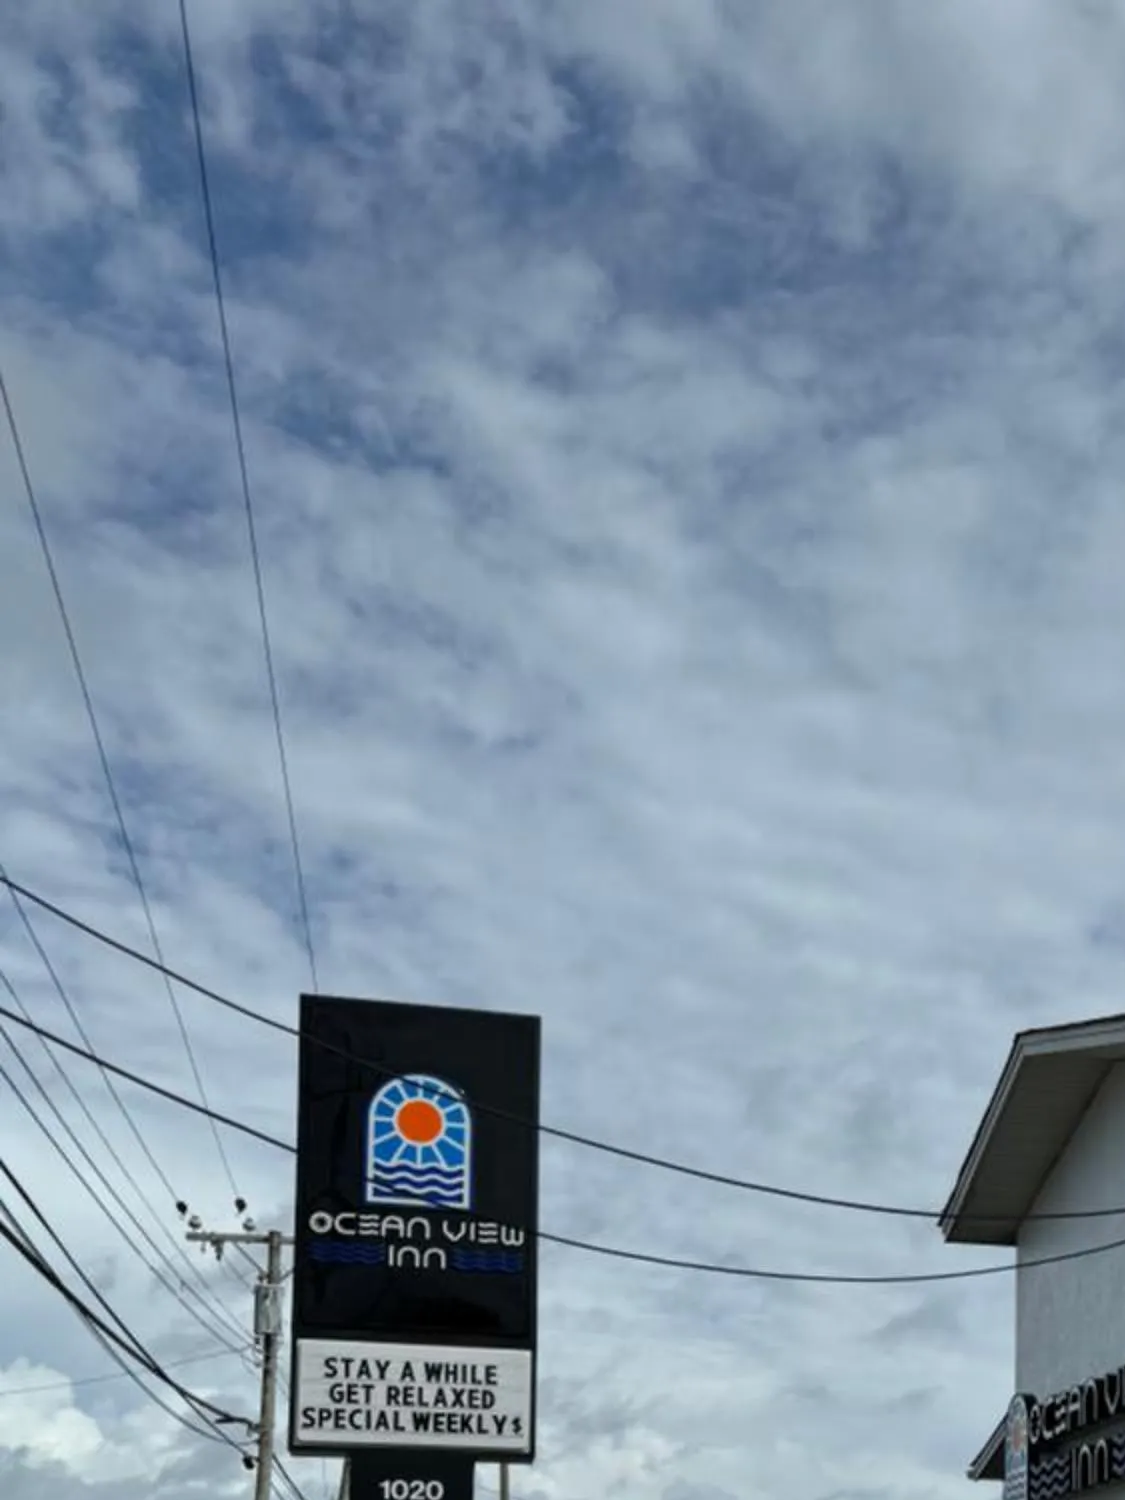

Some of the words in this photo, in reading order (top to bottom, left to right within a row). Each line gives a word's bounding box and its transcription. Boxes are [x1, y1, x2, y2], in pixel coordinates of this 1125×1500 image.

[309, 1211, 431, 1239] OCEAN
[442, 1219, 525, 1246] VIEW
[387, 1245, 447, 1270] INN
[323, 1357, 391, 1381] STAY
[401, 1361, 416, 1382] A
[423, 1362, 498, 1386] WHILE
[329, 1383, 375, 1405] GET
[386, 1386, 496, 1410] RELAXED
[301, 1407, 405, 1432] SPECIAL
[1028, 1379, 1099, 1444] OCEAN
[1071, 1439, 1109, 1492] INN
[378, 1479, 444, 1500] 1020
